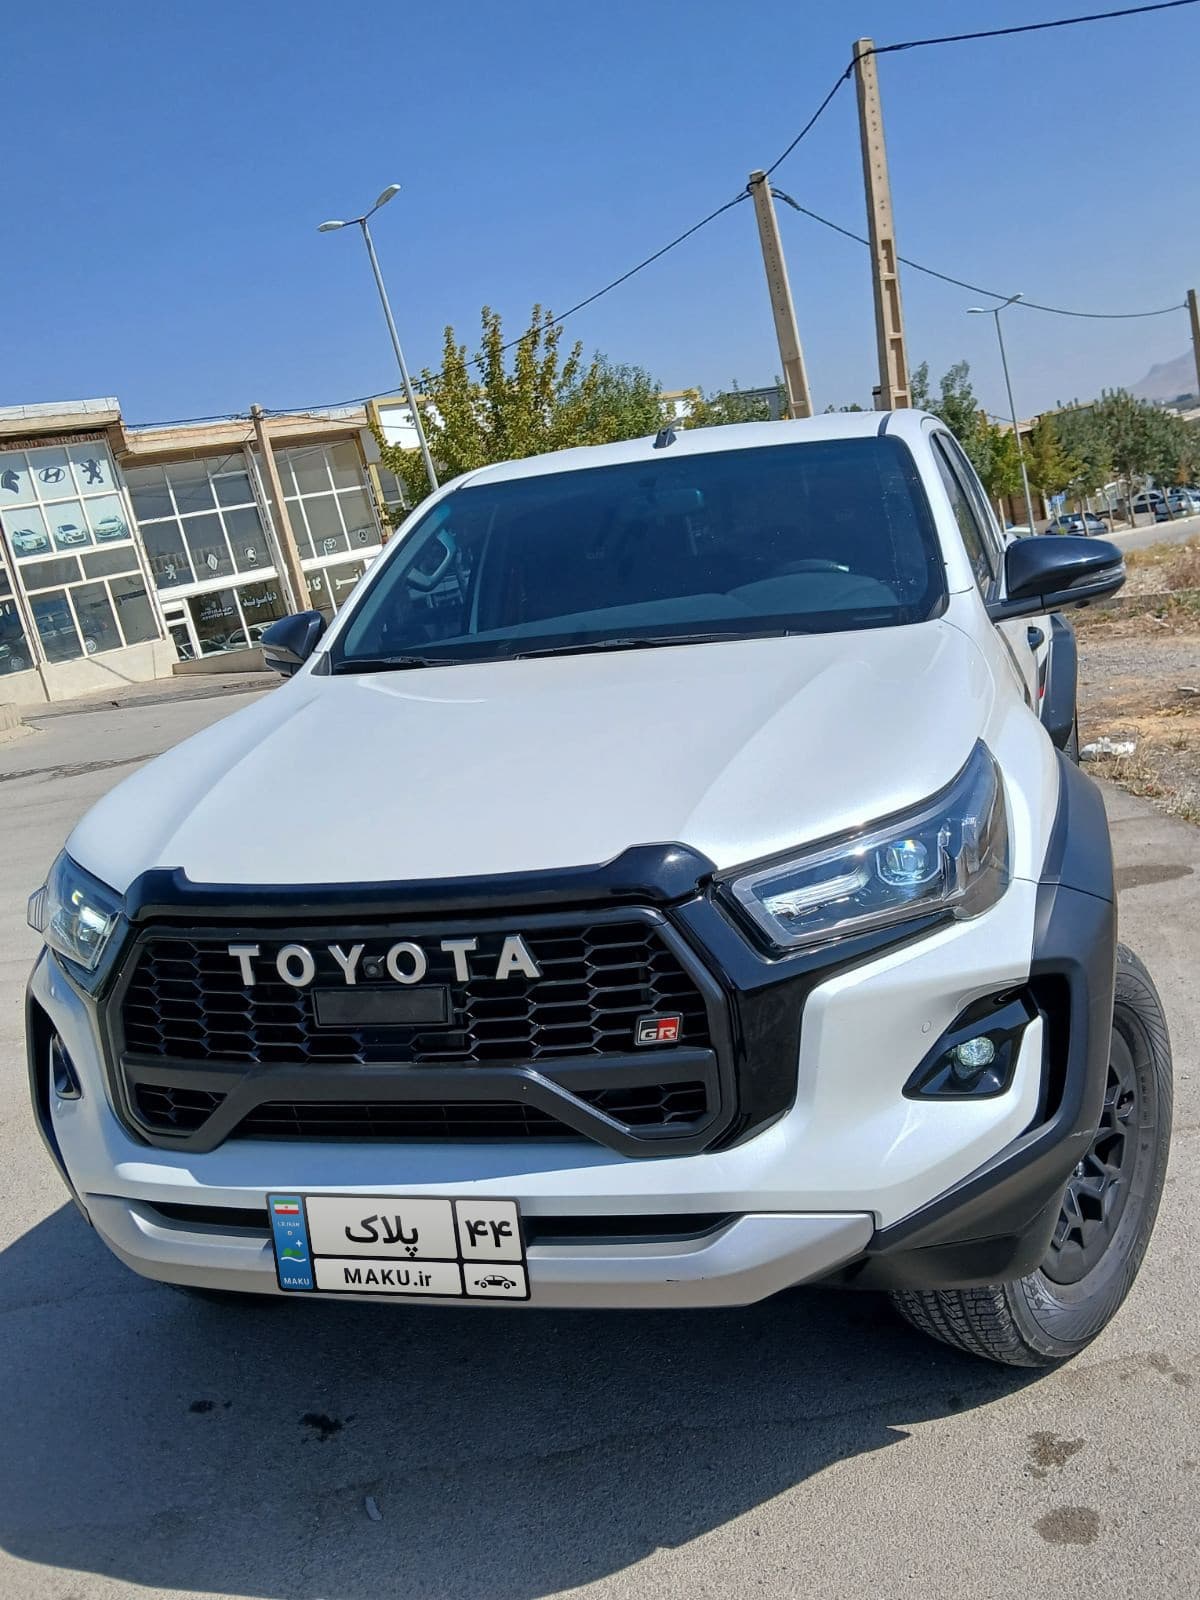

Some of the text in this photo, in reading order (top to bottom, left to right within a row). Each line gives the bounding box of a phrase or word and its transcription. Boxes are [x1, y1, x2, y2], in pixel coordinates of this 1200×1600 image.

[228, 934, 542, 987] TOYOTA
[640, 1027, 677, 1041] GR
[344, 1215, 419, 1258] پلاک
[464, 1219, 513, 1248] ۴۴
[283, 1277, 310, 1286] MAKU
[343, 1267, 432, 1287] MAKU.ir
